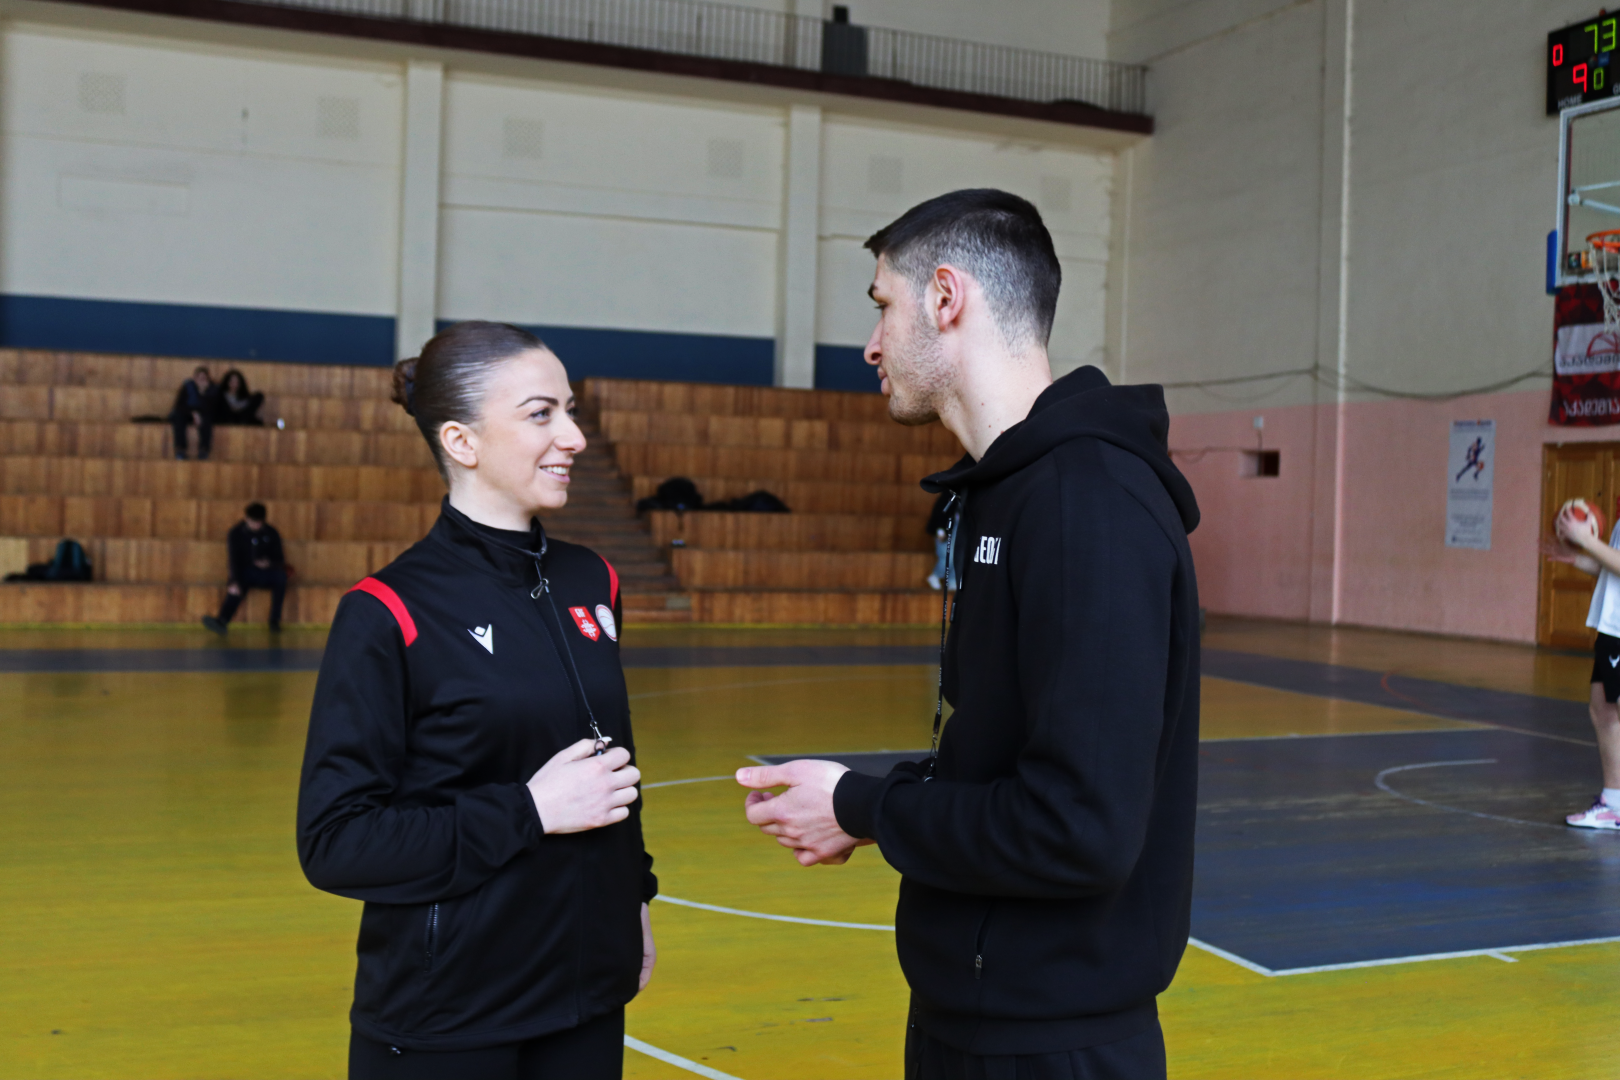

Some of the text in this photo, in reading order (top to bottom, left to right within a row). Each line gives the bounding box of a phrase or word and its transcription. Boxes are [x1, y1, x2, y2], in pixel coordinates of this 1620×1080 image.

[1584, 18, 1616, 53] 73
[1552, 43, 1563, 67] 0
[1572, 62, 1587, 93] 9
[1593, 66, 1604, 91] 0
